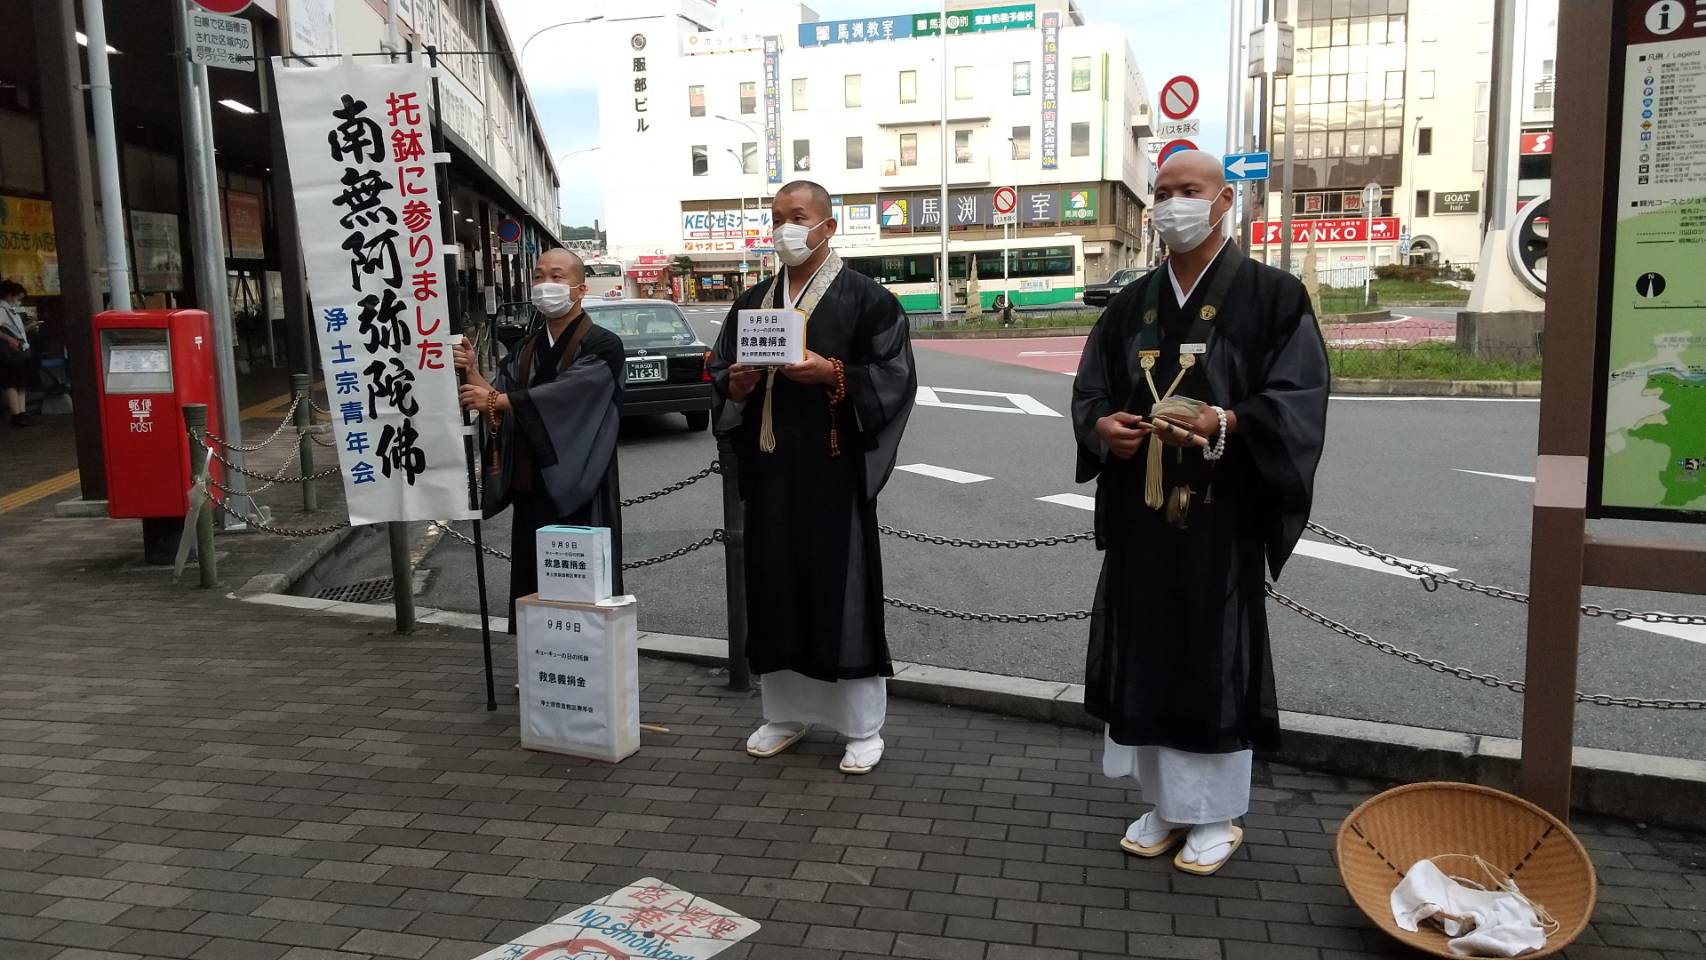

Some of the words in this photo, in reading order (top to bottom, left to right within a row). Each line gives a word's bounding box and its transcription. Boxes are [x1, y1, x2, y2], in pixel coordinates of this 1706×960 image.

[631, 57, 650, 133] 服部ビル
[1162, 122, 1199, 135] バスを除く
[386, 92, 445, 372] 托鉢に参りました
[694, 240, 735, 251] ヤオヒコ
[327, 94, 427, 487] 南無阿弥陀佛
[740, 336, 787, 347] 救急義捐金
[635, 369, 659, 379] 16-58
[323, 307, 377, 486] 浄土宗青年会
[128, 399, 152, 411] 郵便
[130, 422, 153, 432] POST
[551, 541, 577, 549] 9月9日
[544, 558, 587, 571] 救急義捐金
[547, 620, 582, 633] 9月9日
[538, 671, 586, 688] 救急義捐金
[627, 886, 743, 938] 路上喫煙
[620, 906, 693, 943] 禁止
